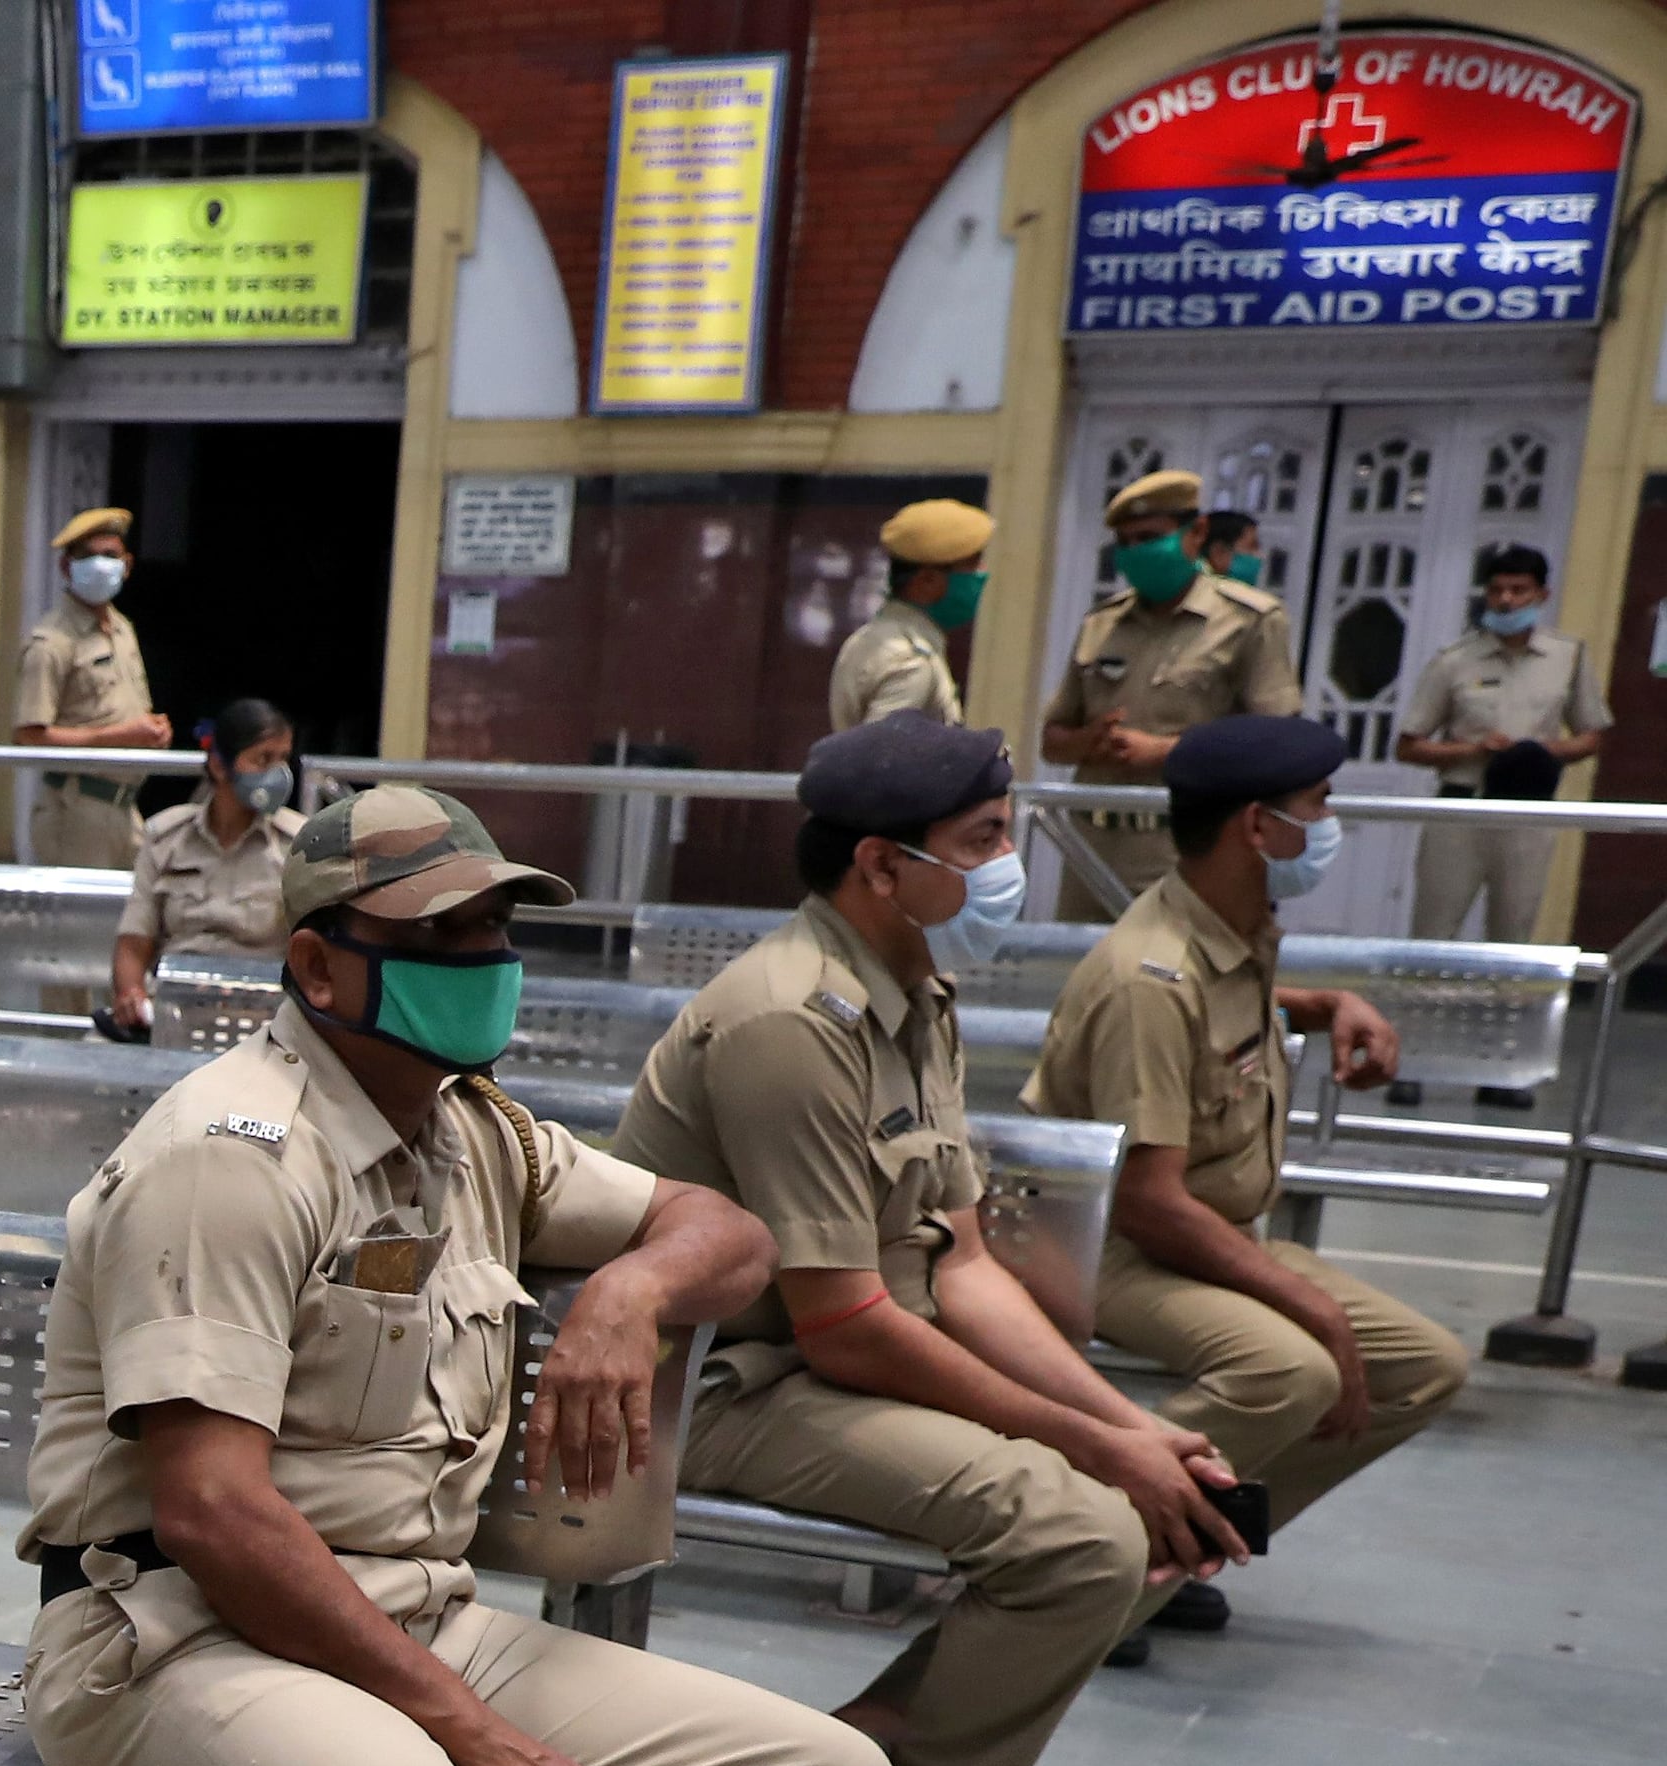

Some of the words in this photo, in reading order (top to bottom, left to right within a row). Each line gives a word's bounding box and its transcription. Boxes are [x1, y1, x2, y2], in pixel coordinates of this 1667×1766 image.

[1088, 76, 1218, 155] LIONS
[1354, 50, 1415, 86] OF
[1423, 53, 1621, 134] HOWRAH
[1083, 238, 1287, 286] प्राथमिक
[1300, 243, 1465, 280] उपचार
[1476, 230, 1593, 277] केन्द्र
[119, 306, 215, 327] STATION
[224, 304, 341, 326] MANAGER
[1080, 294, 1261, 331] FIRST
[1269, 290, 1383, 325] AID
[1399, 285, 1586, 323] POST
[227, 1112, 287, 1143] WBRP
